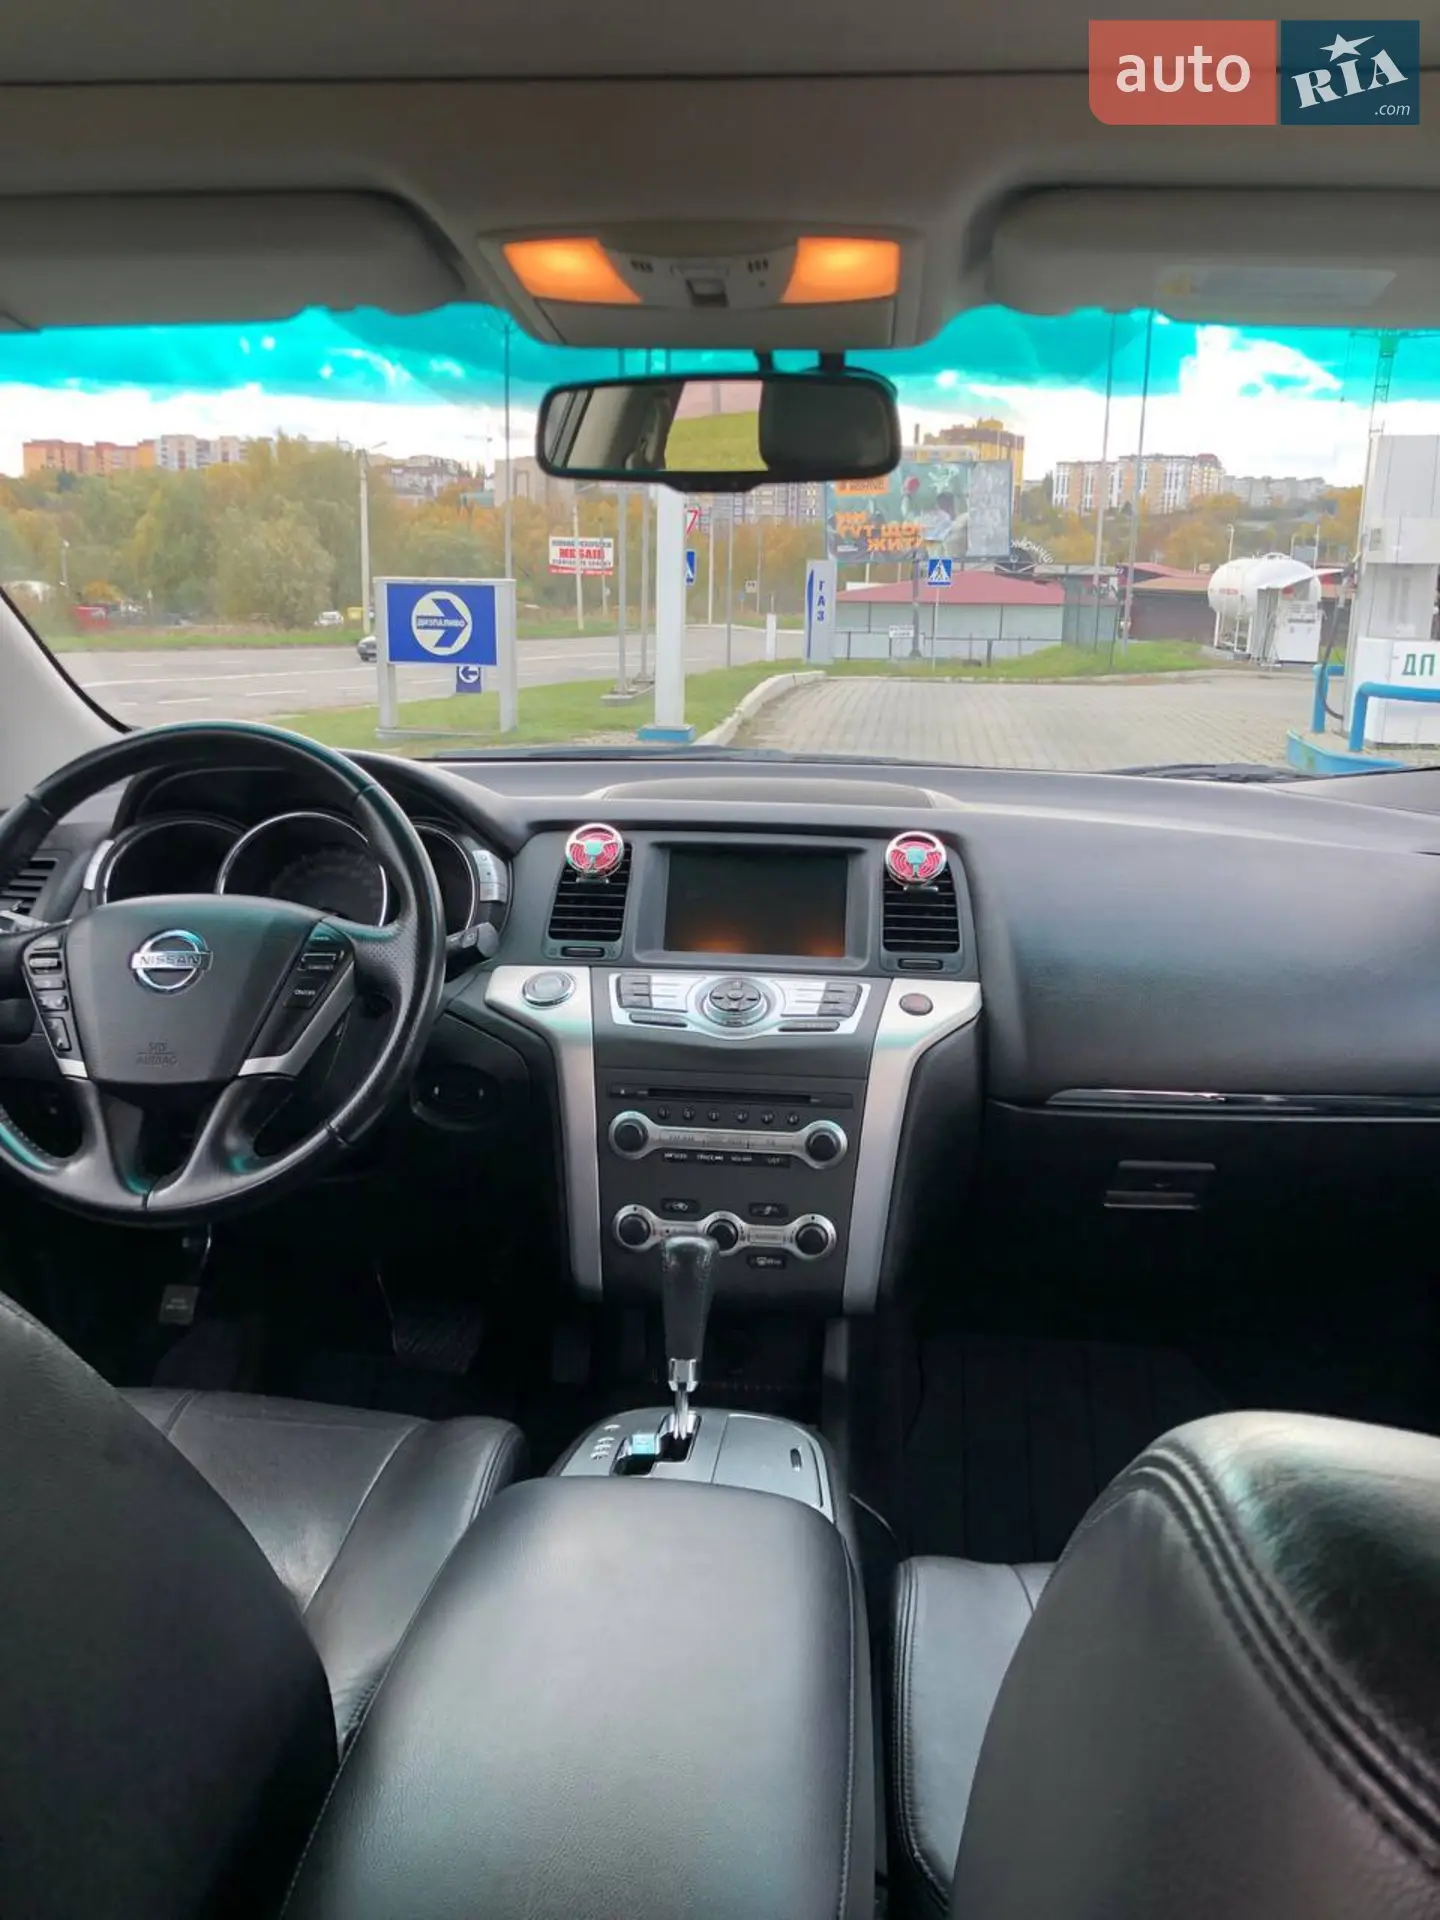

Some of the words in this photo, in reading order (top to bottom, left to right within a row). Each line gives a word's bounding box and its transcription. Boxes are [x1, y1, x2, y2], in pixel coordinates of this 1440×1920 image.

[817, 580, 826, 622] ГАЗ
[1401, 653, 1436, 676] ДП
[140, 954, 202, 967] NISSAN
